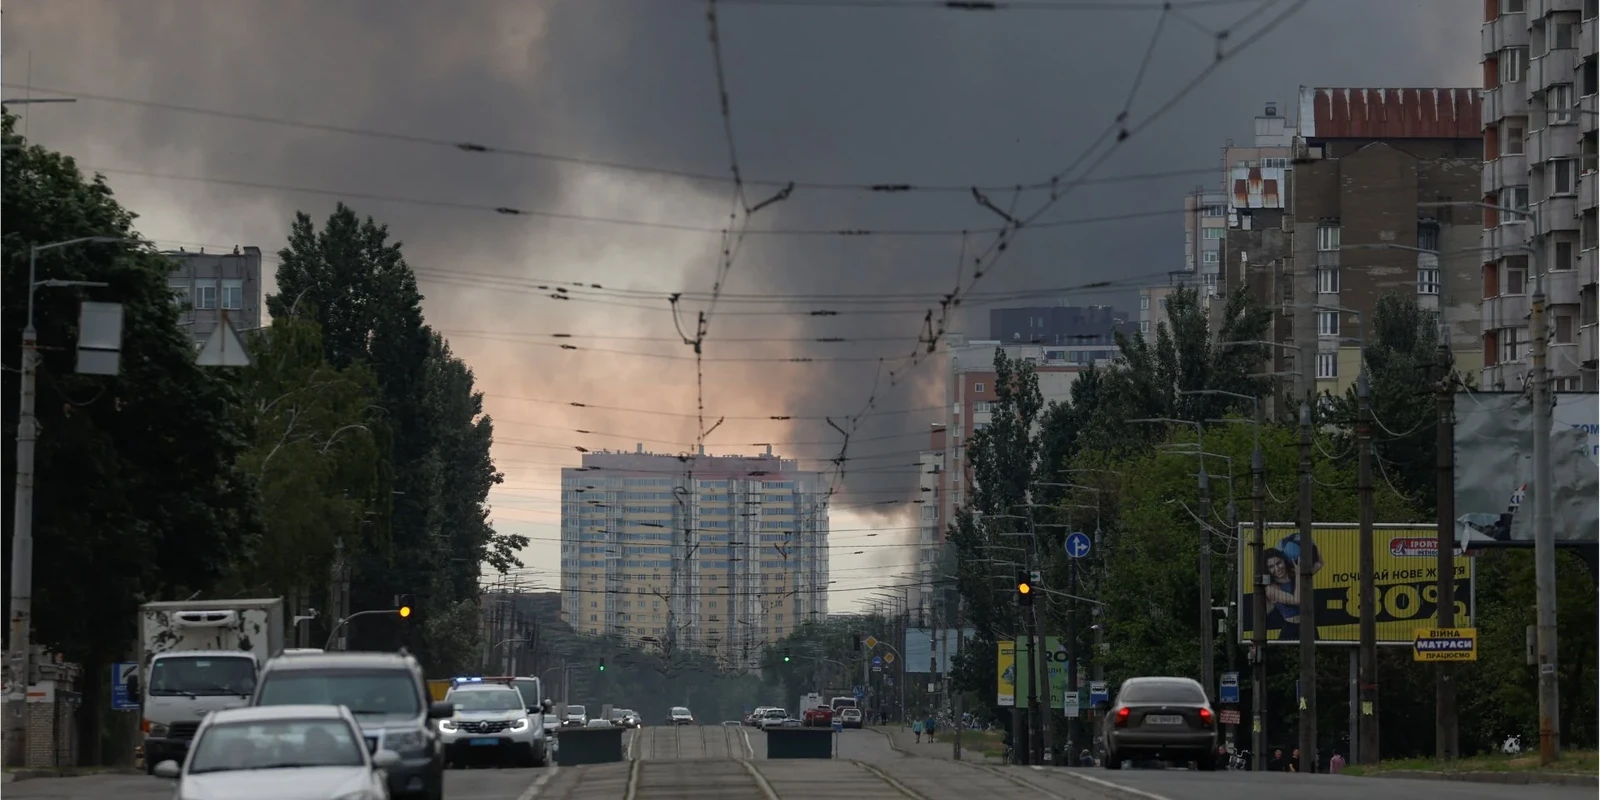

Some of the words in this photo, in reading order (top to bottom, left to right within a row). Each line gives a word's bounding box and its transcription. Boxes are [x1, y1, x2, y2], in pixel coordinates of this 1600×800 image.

[1332, 569, 1389, 583] ПОЧИАЙ
[1393, 568, 1423, 580] НОВЕ
[1426, 566, 1465, 577] ЖТЯ
[1326, 585, 1467, 618] -80%
[1417, 640, 1472, 648] МАТРАСИ
